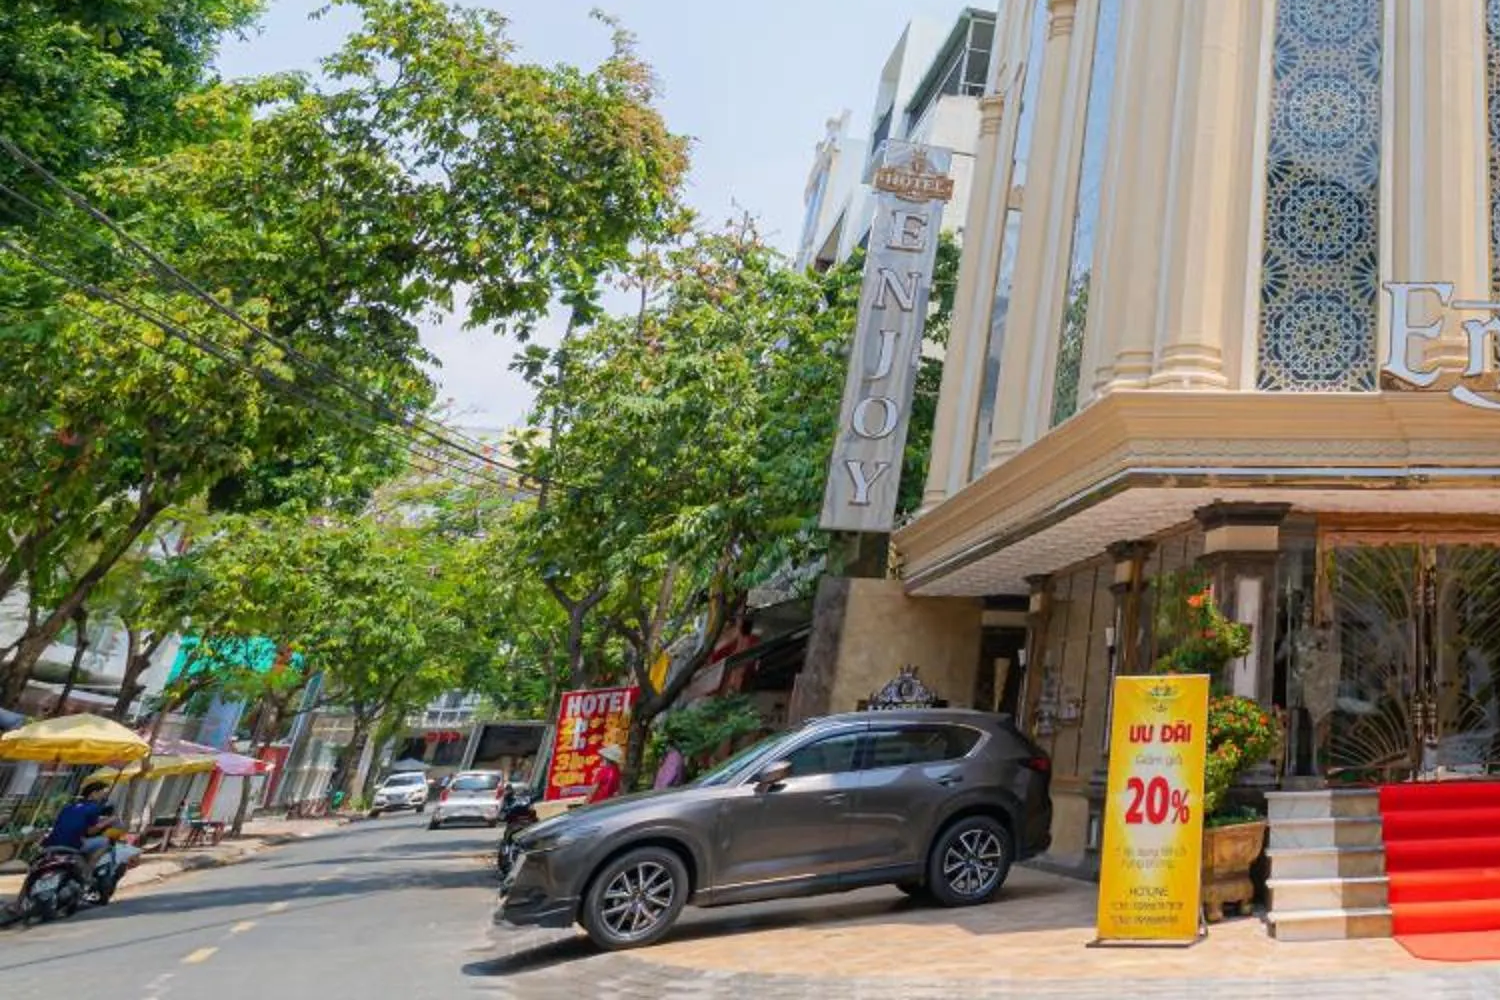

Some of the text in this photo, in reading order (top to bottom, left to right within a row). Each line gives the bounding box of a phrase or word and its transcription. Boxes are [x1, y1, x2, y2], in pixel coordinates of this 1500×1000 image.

[845, 210, 930, 506] ENJOY
[567, 691, 631, 718] HOTEL
[1125, 776, 1190, 825] 20%
